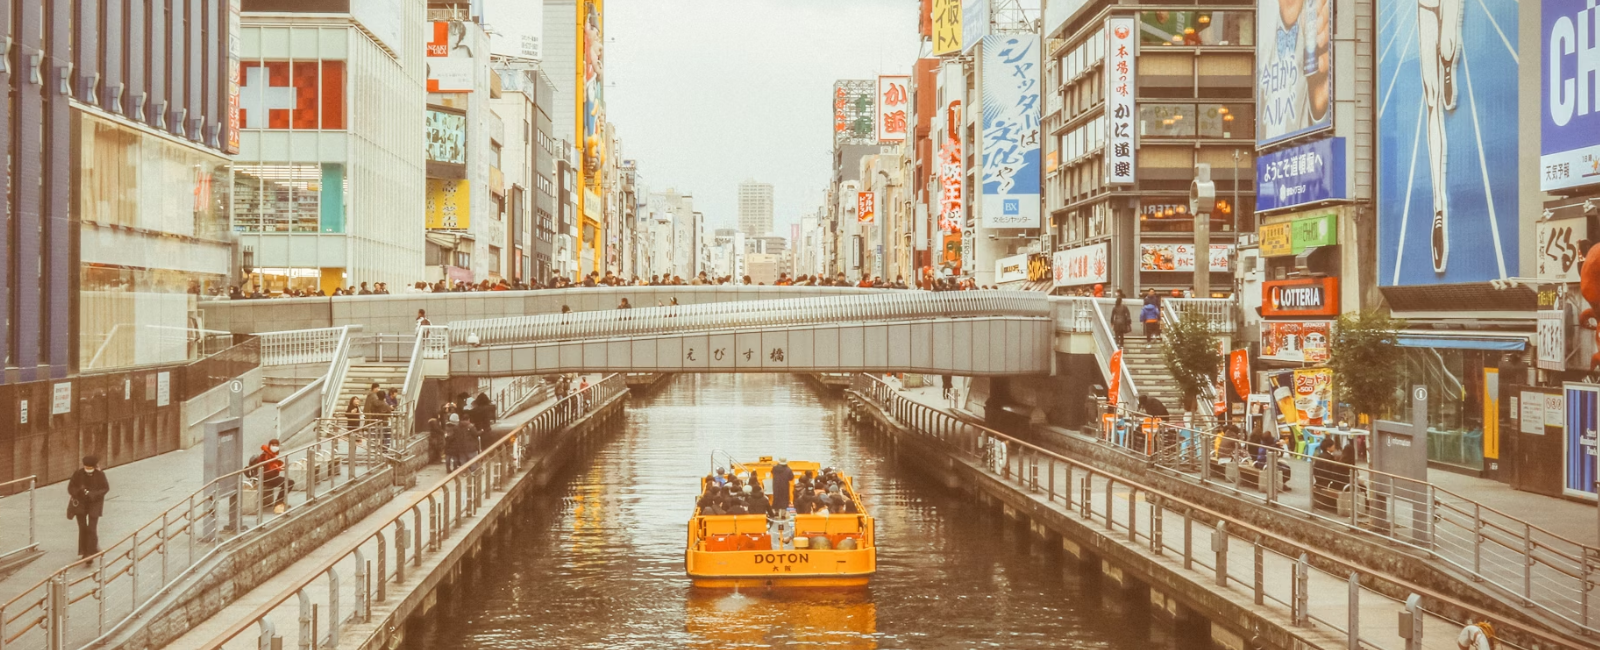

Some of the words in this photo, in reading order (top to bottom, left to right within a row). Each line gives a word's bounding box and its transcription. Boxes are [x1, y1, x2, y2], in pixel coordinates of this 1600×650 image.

[1115, 43, 1129, 98] 本場の味
[1261, 55, 1298, 96] 今日から
[1263, 92, 1296, 127] ヘルベ
[1264, 152, 1323, 182] ようこそ道頓堀へ
[1546, 162, 1570, 181] 天気予報
[865, 193, 873, 213] ツルハ
[1004, 202, 1018, 212] BX
[1280, 287, 1321, 307] LOTTERIA
[686, 348, 784, 363] えびす橋
[754, 553, 809, 564] DOTON
